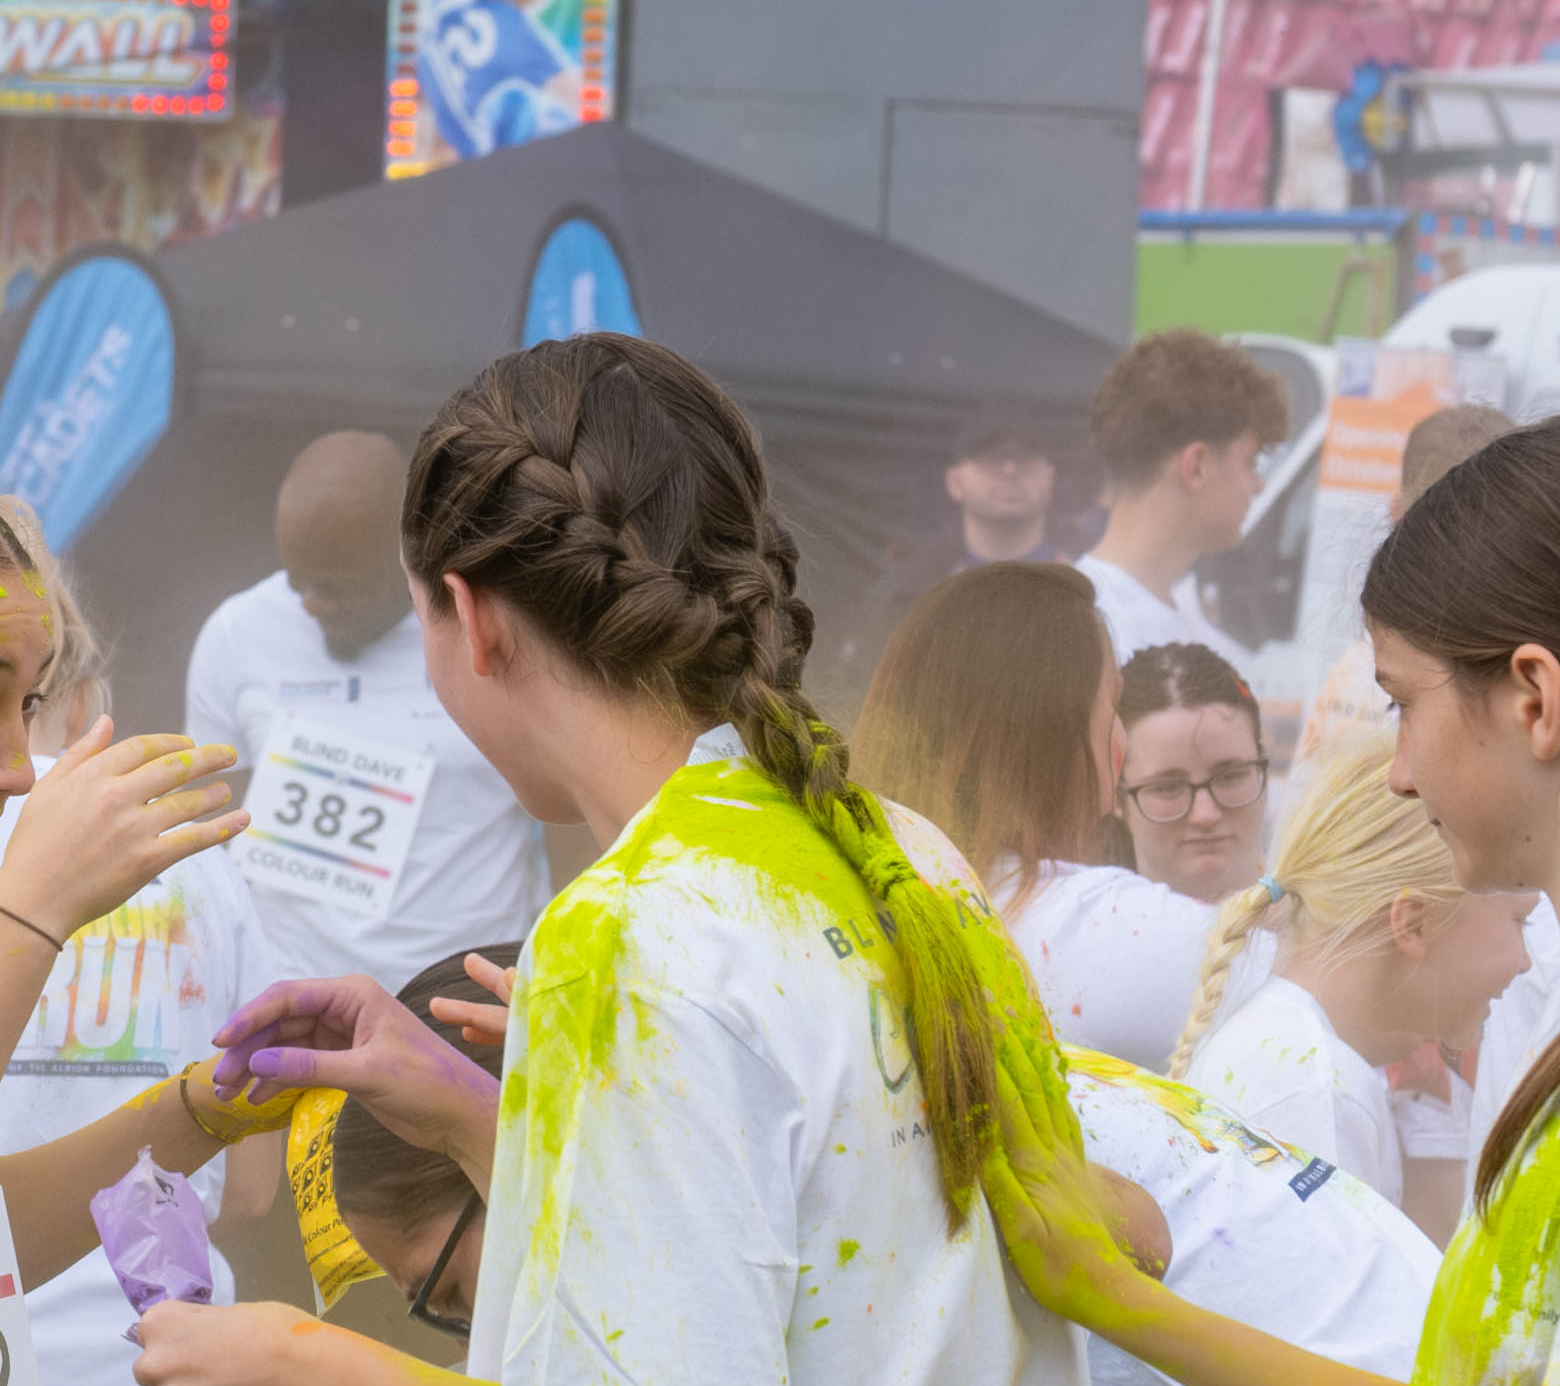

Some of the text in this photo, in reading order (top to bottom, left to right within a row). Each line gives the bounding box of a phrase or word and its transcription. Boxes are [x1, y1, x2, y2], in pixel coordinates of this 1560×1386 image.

[291, 736, 406, 783] BLIND DAVE
[275, 782, 385, 852] 382
[249, 847, 375, 900] COLOUR RUN
